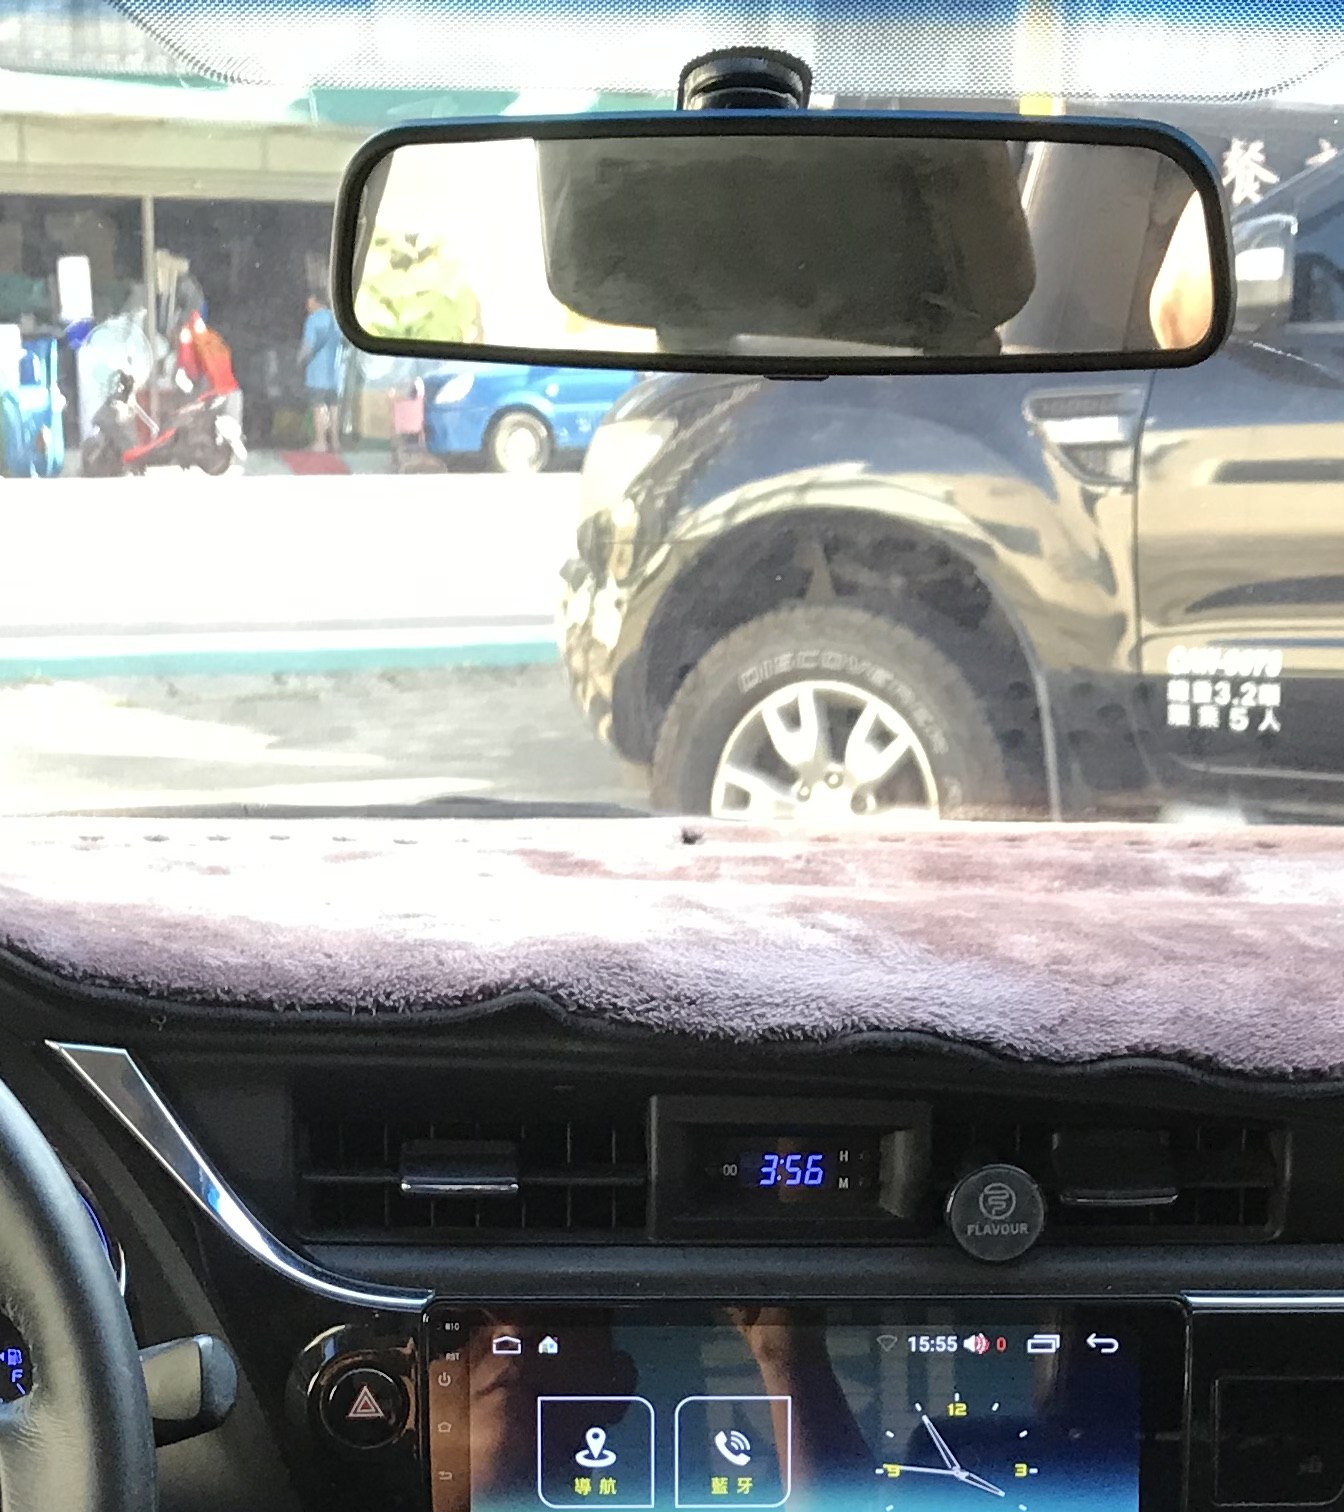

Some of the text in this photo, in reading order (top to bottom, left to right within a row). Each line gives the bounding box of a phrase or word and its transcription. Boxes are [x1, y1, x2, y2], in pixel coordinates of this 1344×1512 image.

[839, 1151, 848, 1162] H
[760, 1155, 824, 1185] 3:56
[838, 1177, 849, 1189] M
[967, 1223, 1029, 1236] FLAVOUR
[908, 1336, 1007, 1352] 15:55 0
[12, 1369, 23, 1383] F
[947, 1403, 967, 1416] 12
[1015, 1463, 1028, 1478] 3
[574, 1477, 617, 1495] 導航
[711, 1477, 753, 1495] 藍牙
